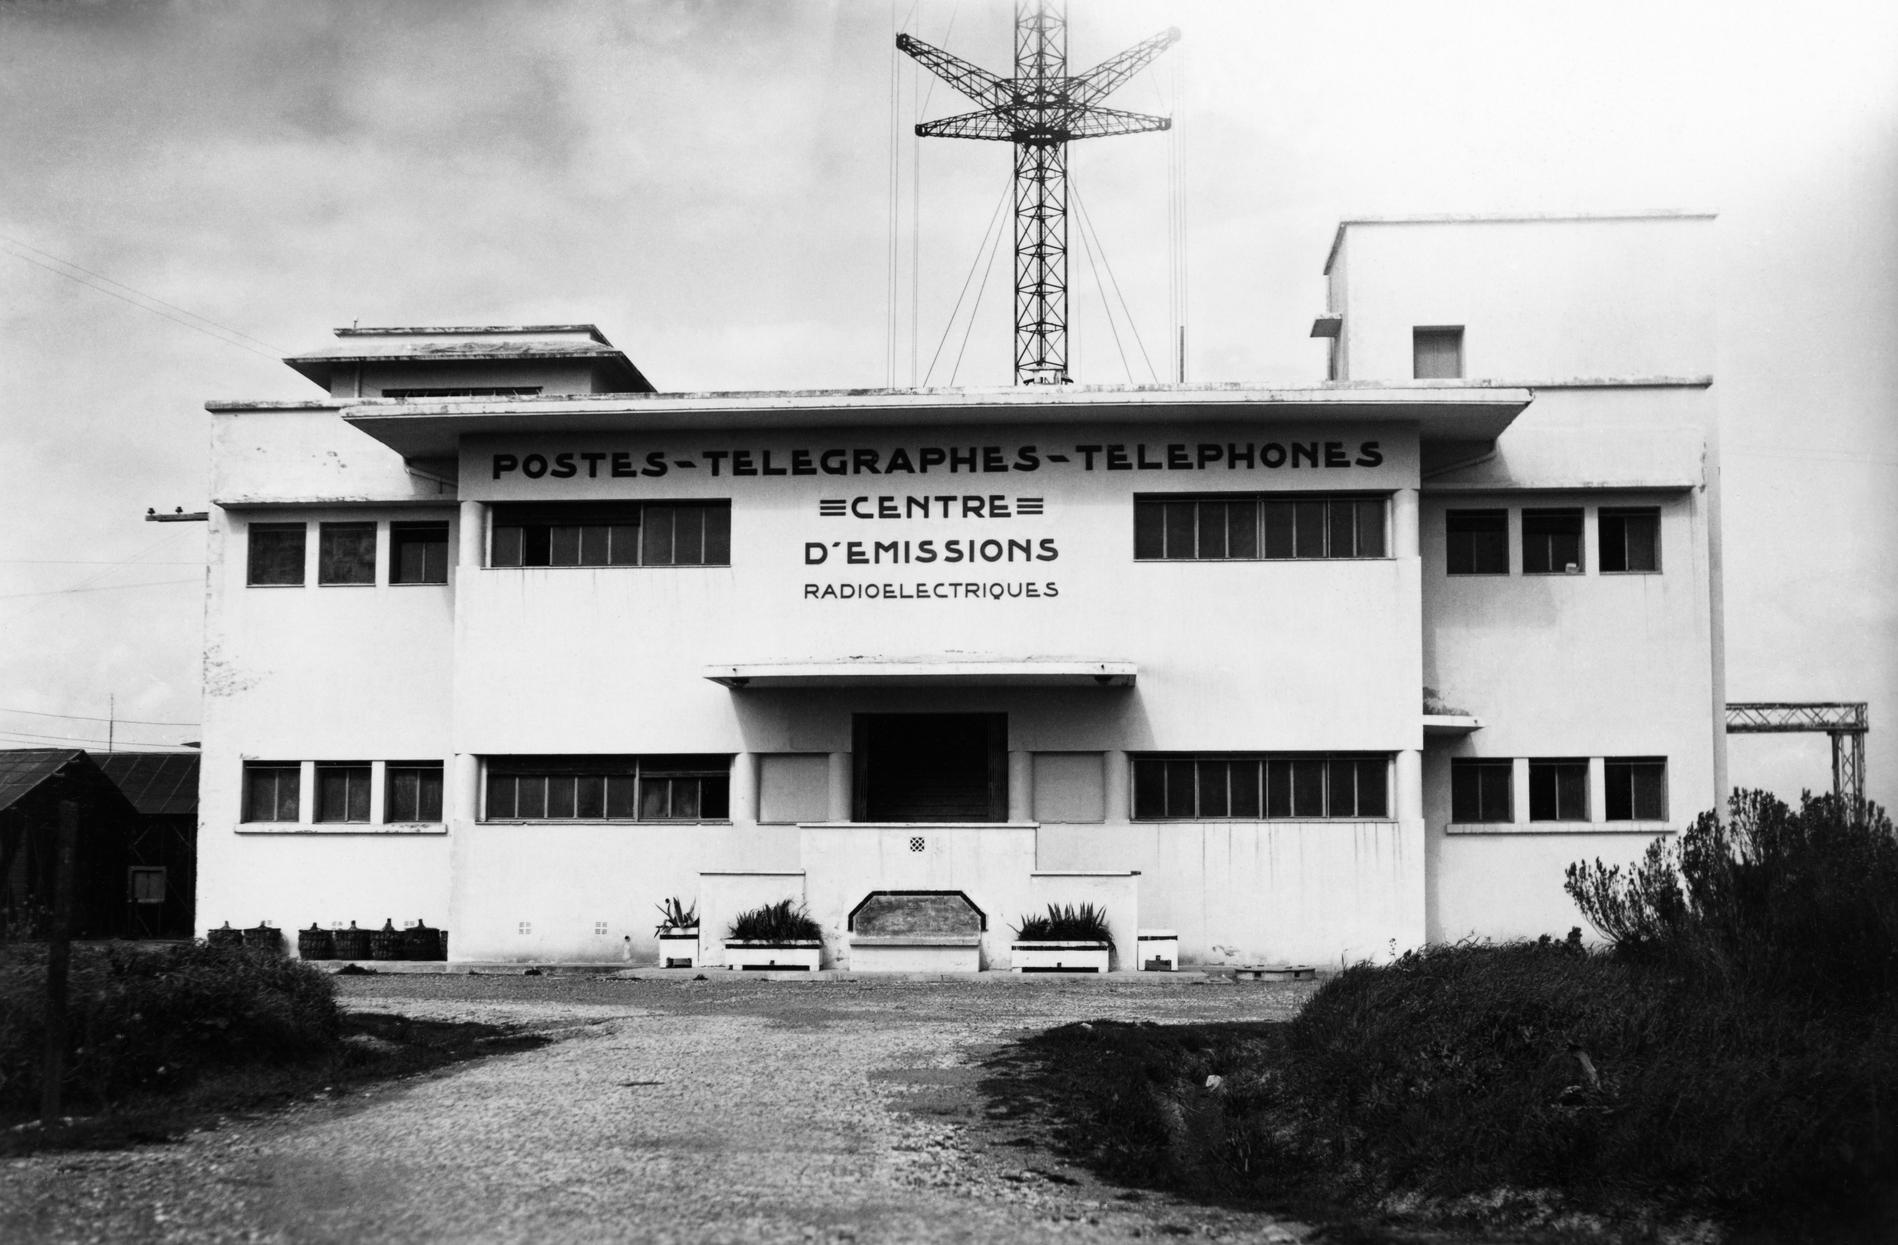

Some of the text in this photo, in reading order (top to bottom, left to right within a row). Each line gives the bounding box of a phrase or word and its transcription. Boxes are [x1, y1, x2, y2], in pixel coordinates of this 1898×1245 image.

[850, 495, 1012, 519] CENTRE
[805, 538, 1059, 565] D'EMISSIONS
[804, 582, 1059, 600] RADIOELECTRIQUES
